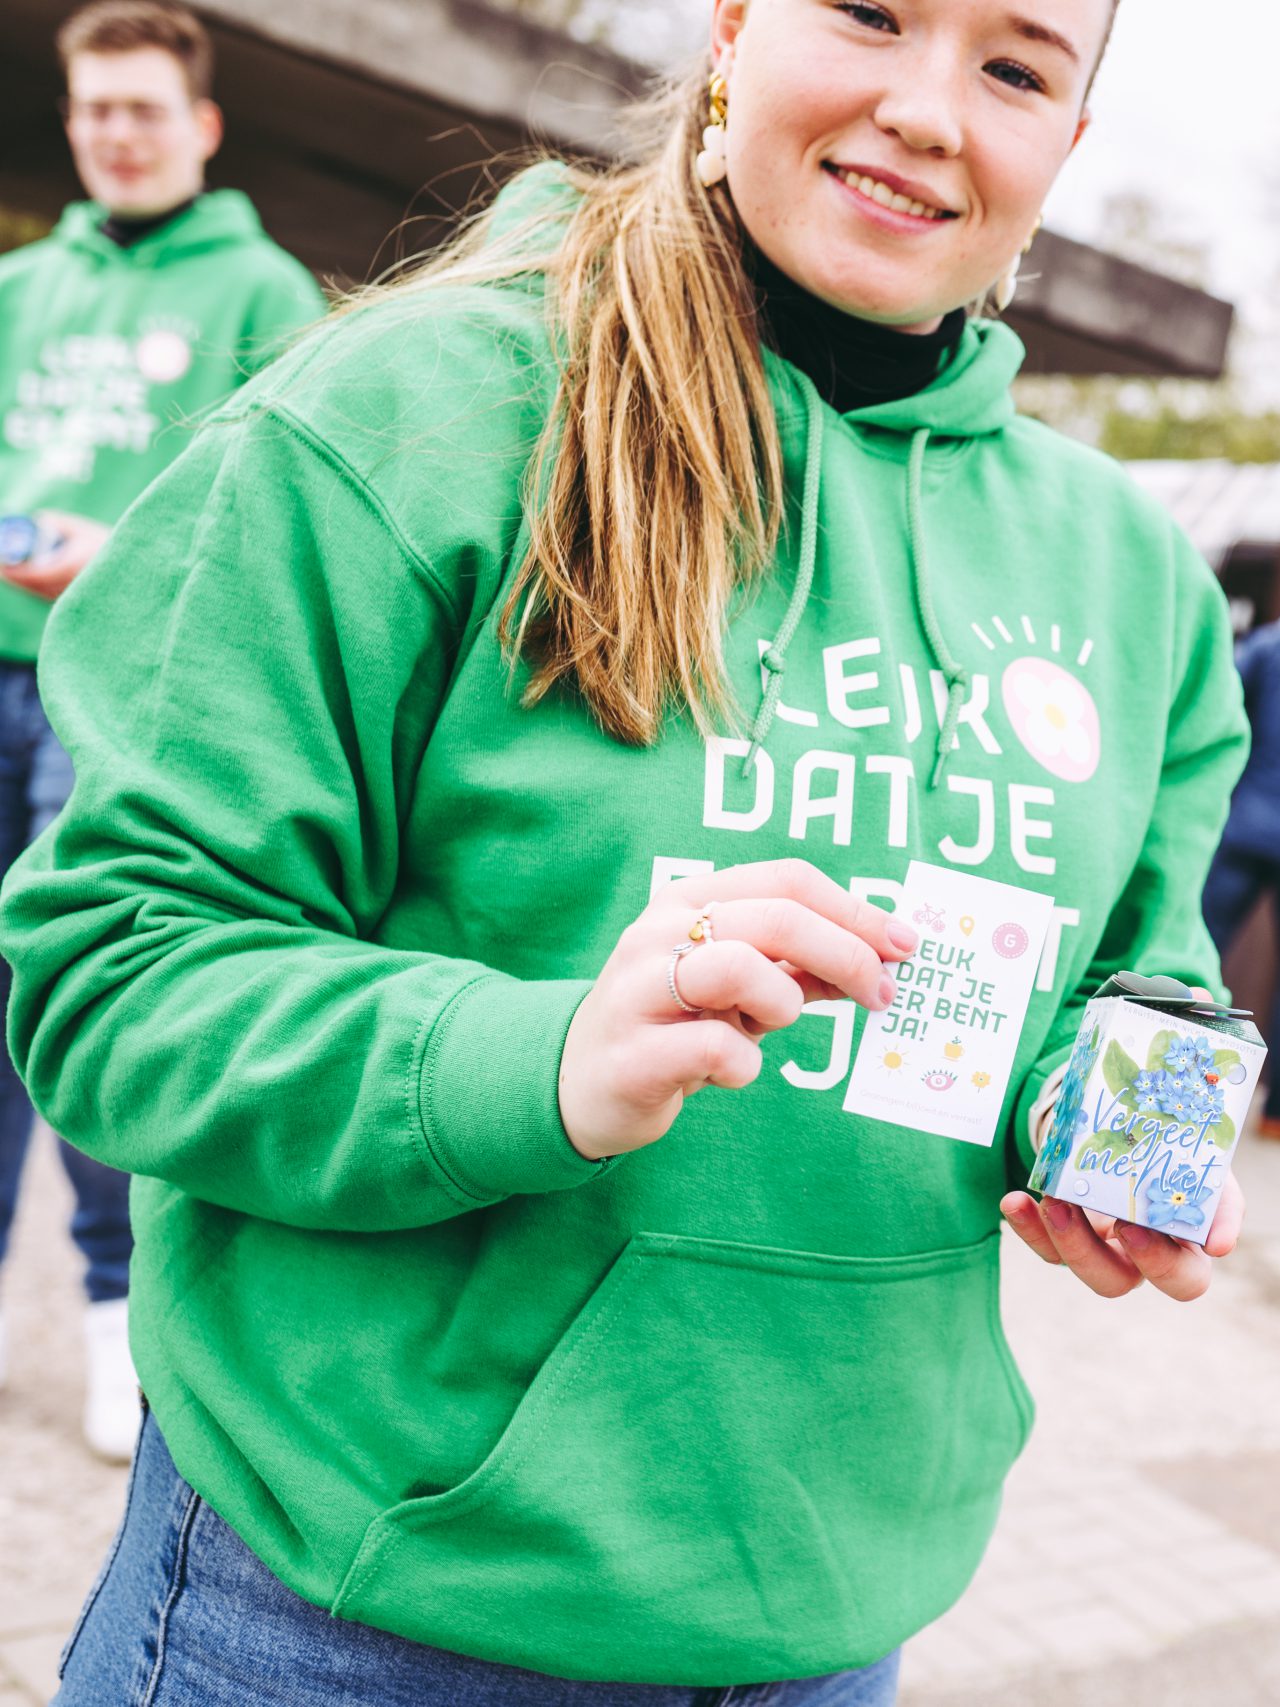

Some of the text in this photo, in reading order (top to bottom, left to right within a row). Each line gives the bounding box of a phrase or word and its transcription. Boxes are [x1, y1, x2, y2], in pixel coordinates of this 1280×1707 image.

[702, 736, 1057, 876] DAT JE
[913, 939, 975, 972] EUK
[1004, 933, 1017, 948] G
[896, 961, 995, 1005] DAT JE
[881, 1012, 928, 1042] JA!
[933, 997, 1007, 1034] BENT
